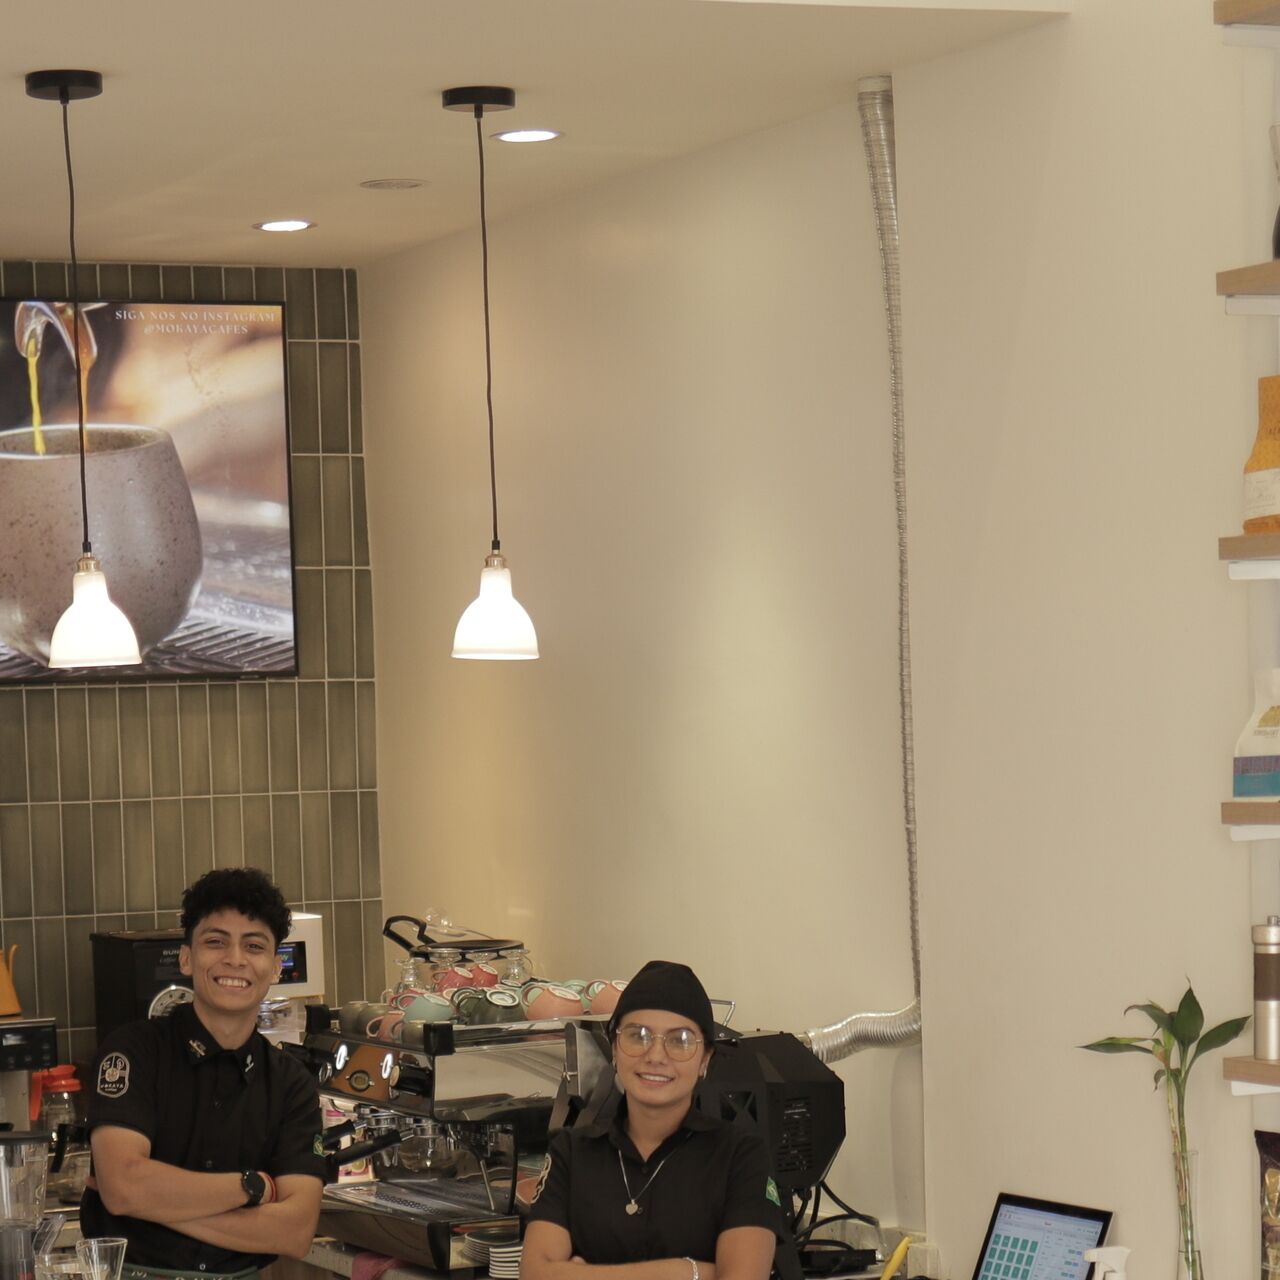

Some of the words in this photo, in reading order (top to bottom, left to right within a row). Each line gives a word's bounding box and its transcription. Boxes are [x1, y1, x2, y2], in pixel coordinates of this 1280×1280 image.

[115, 311, 145, 320] SIGA
[180, 312, 198, 321] NO
[203, 312, 275, 323] INSTAGRAM
